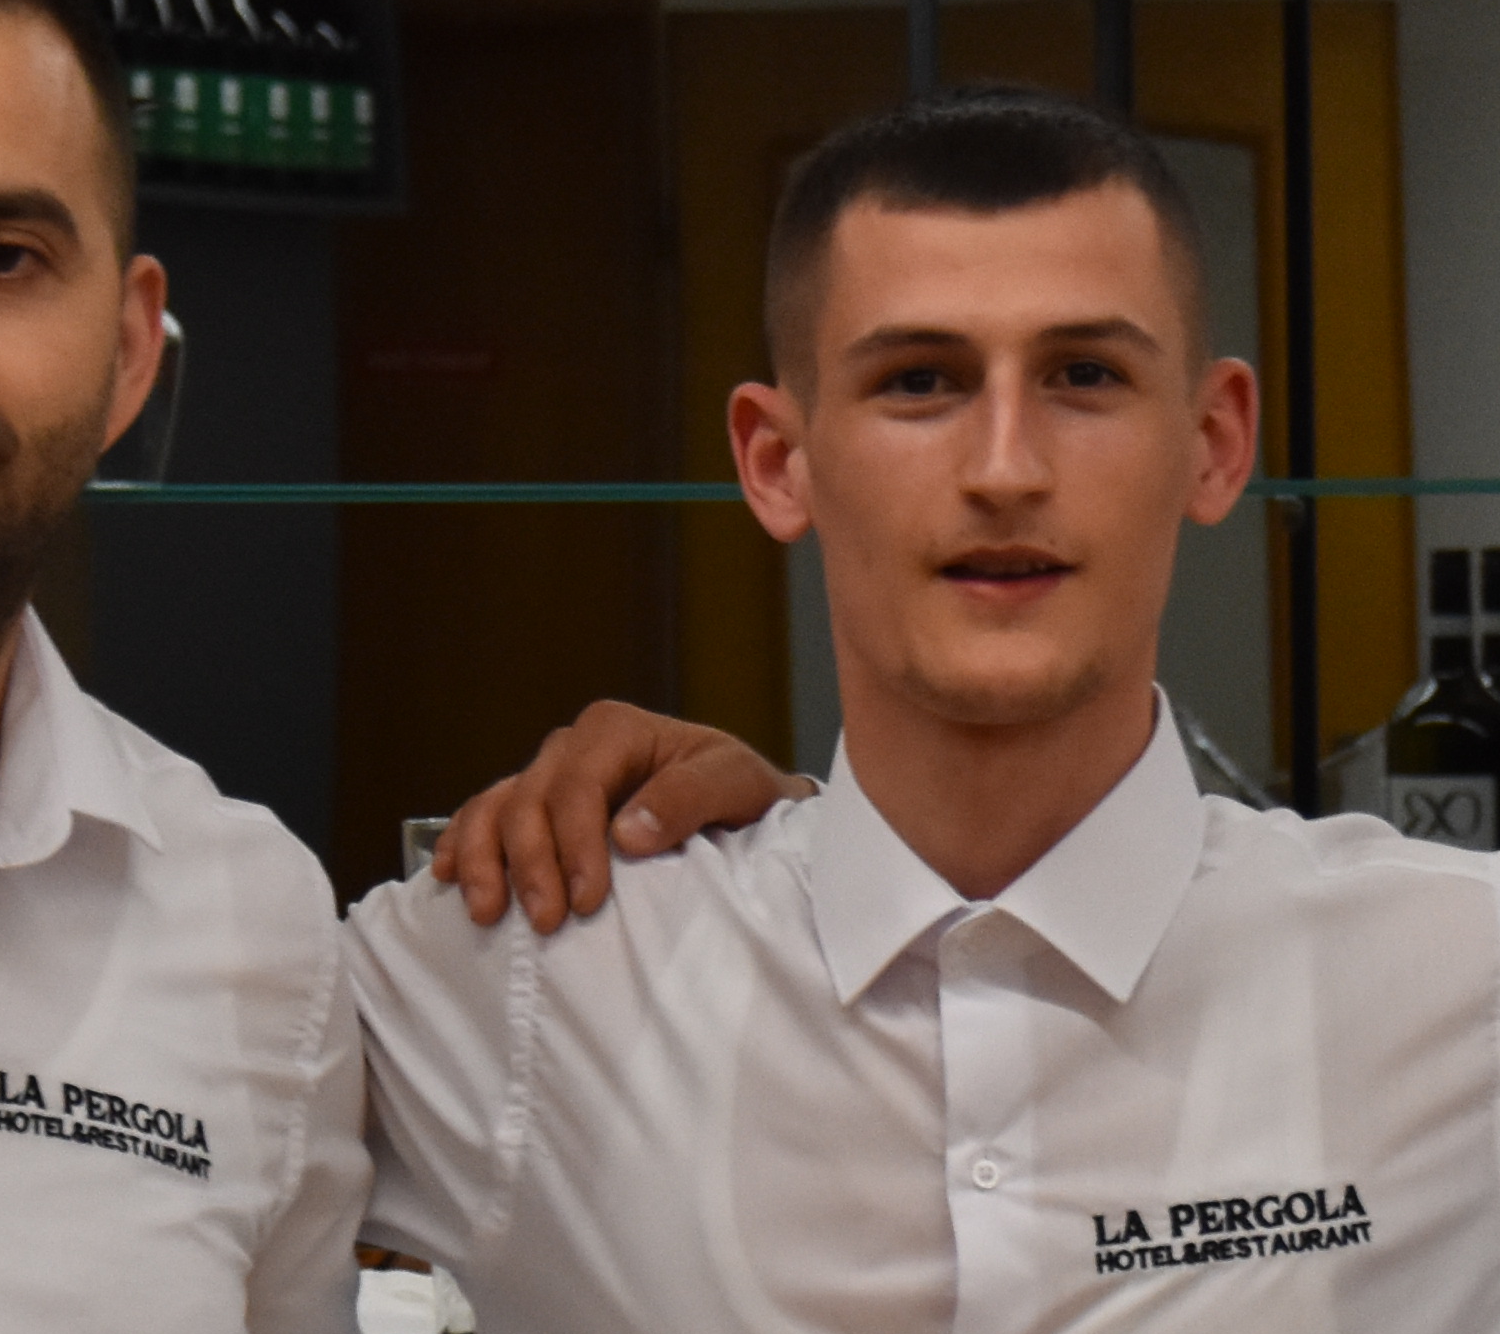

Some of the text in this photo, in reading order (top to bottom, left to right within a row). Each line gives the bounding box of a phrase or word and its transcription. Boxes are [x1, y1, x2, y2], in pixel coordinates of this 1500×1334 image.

[61, 1081, 210, 1154] PERGOLA
[1092, 1183, 1368, 1247] LA PERGOLA
[1095, 1220, 1373, 1275] HOTEL&RESTAURANT
